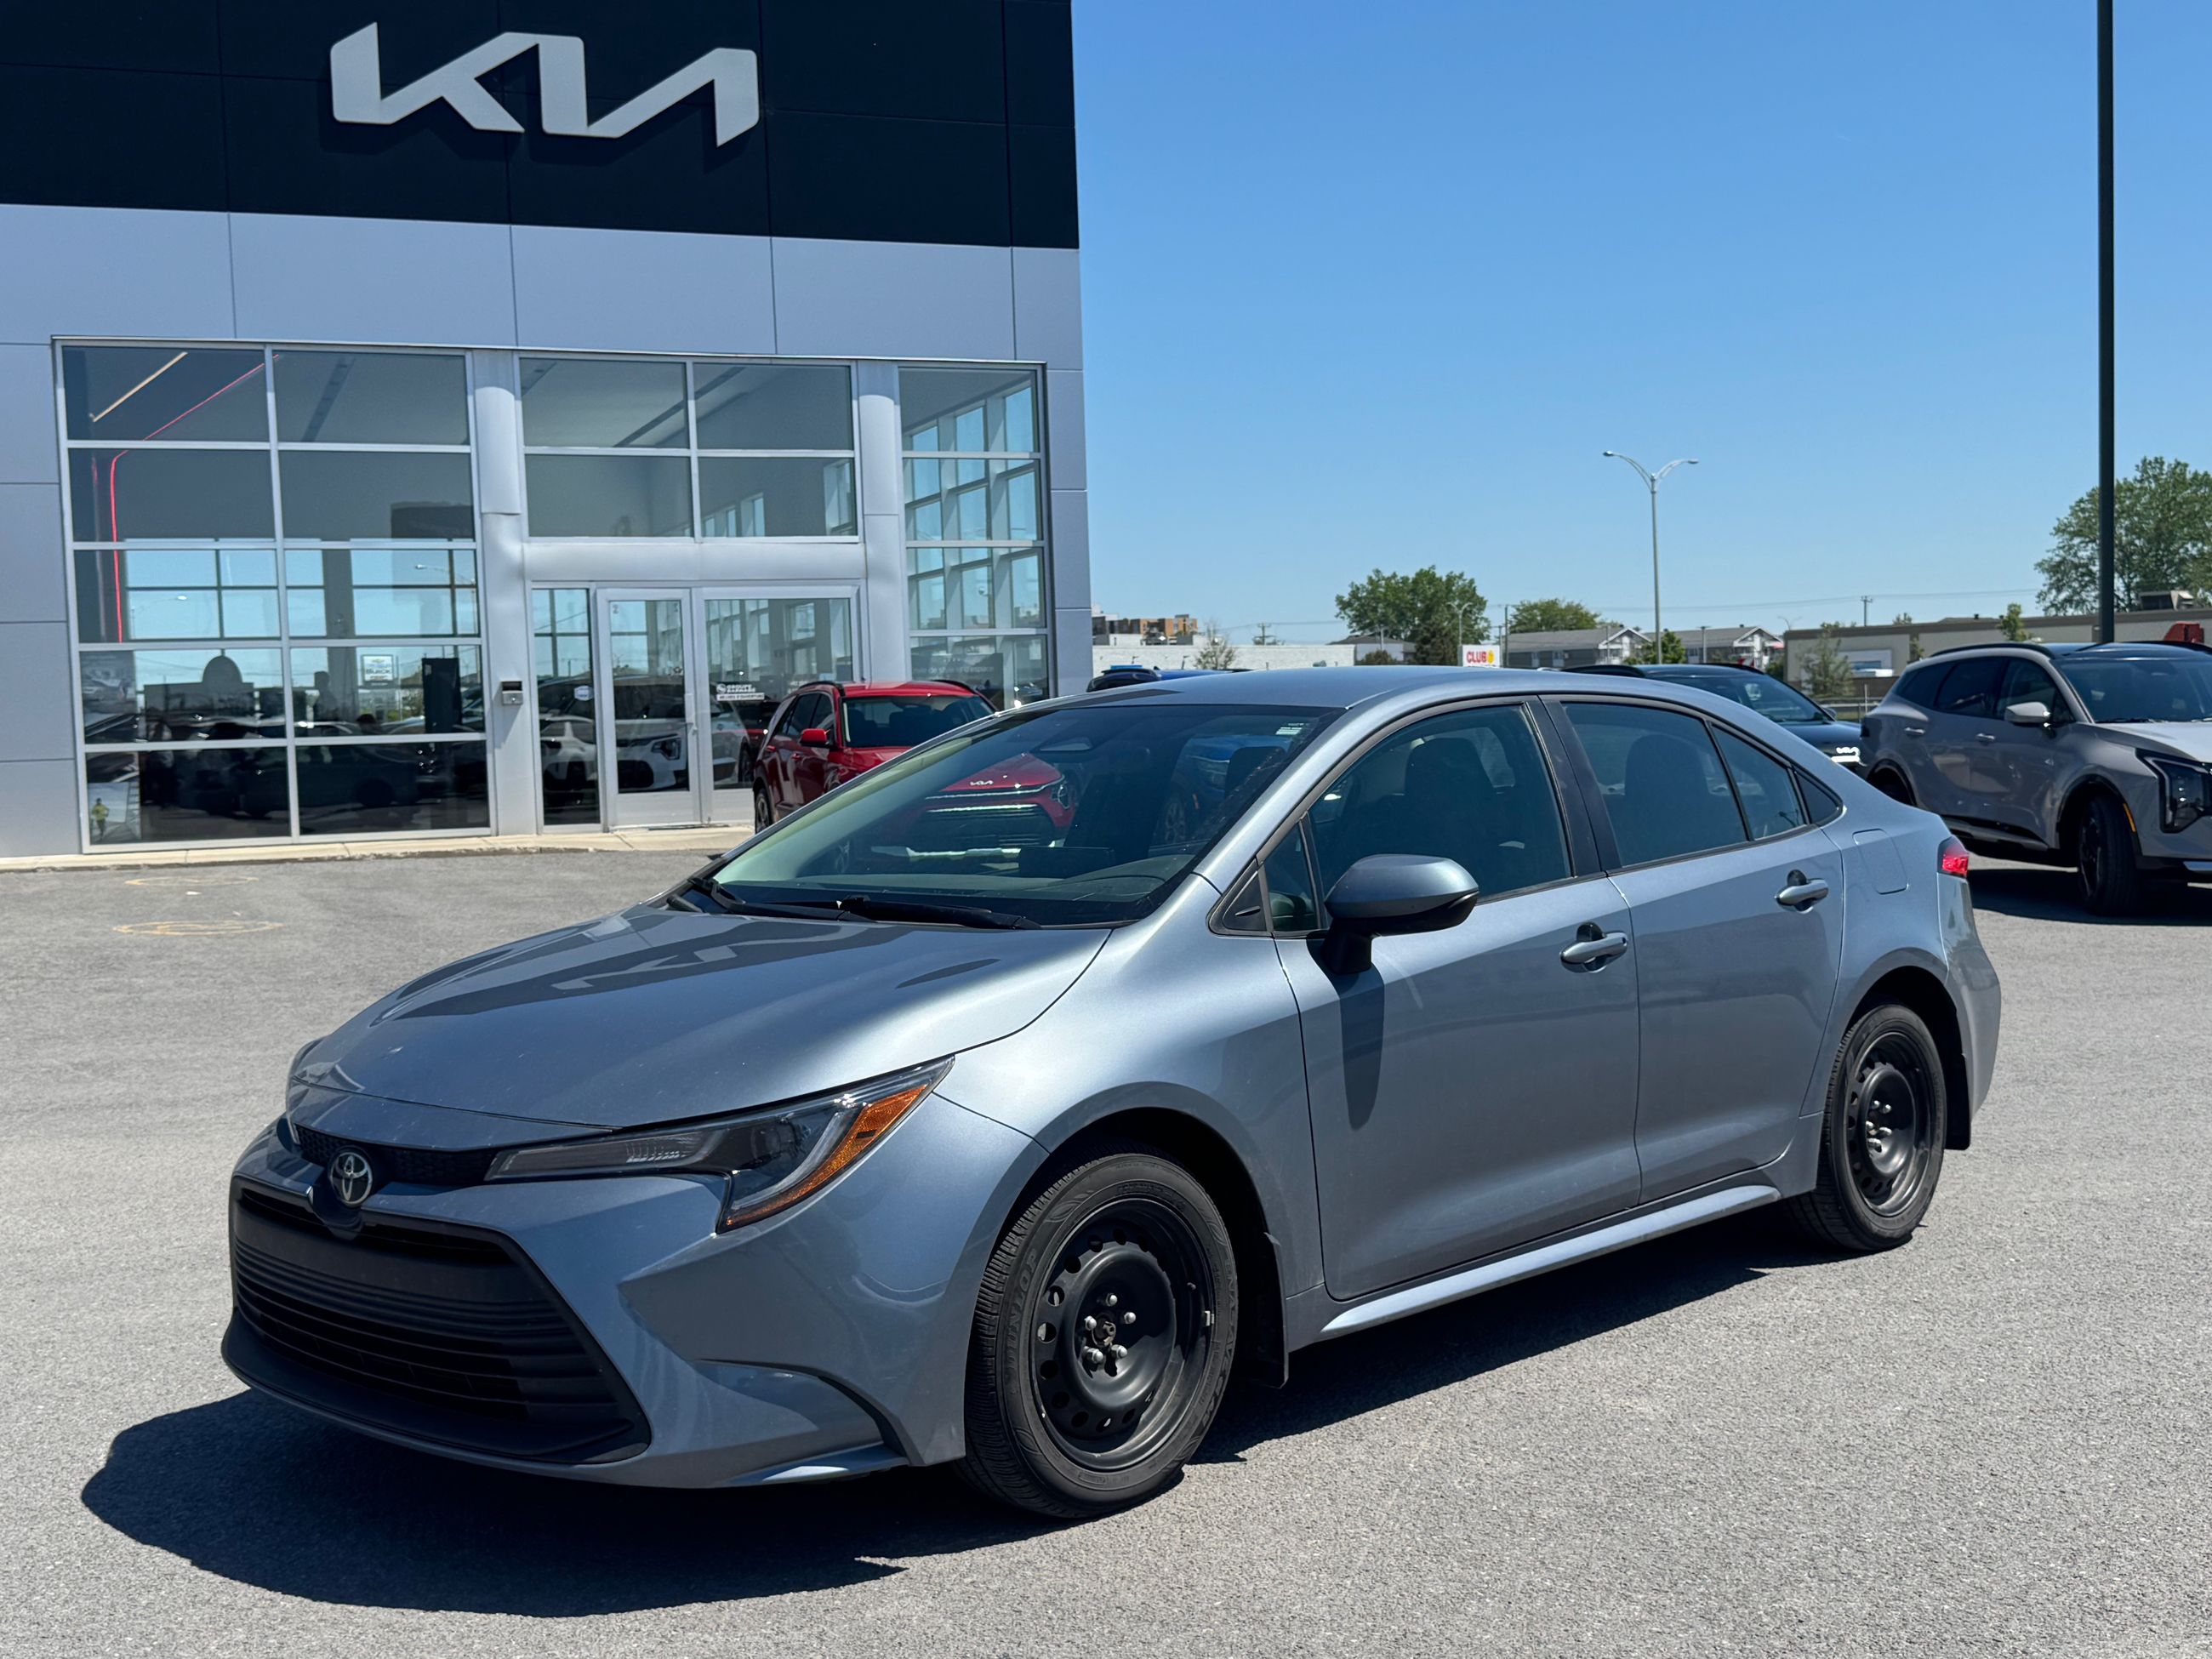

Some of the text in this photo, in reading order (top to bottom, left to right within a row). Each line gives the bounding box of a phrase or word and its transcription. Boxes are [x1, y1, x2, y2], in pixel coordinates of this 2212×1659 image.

[330, 21, 760, 148] KIA
[1467, 650, 1487, 664] CLUB
[1006, 1248, 1037, 1369] DUNLOP
